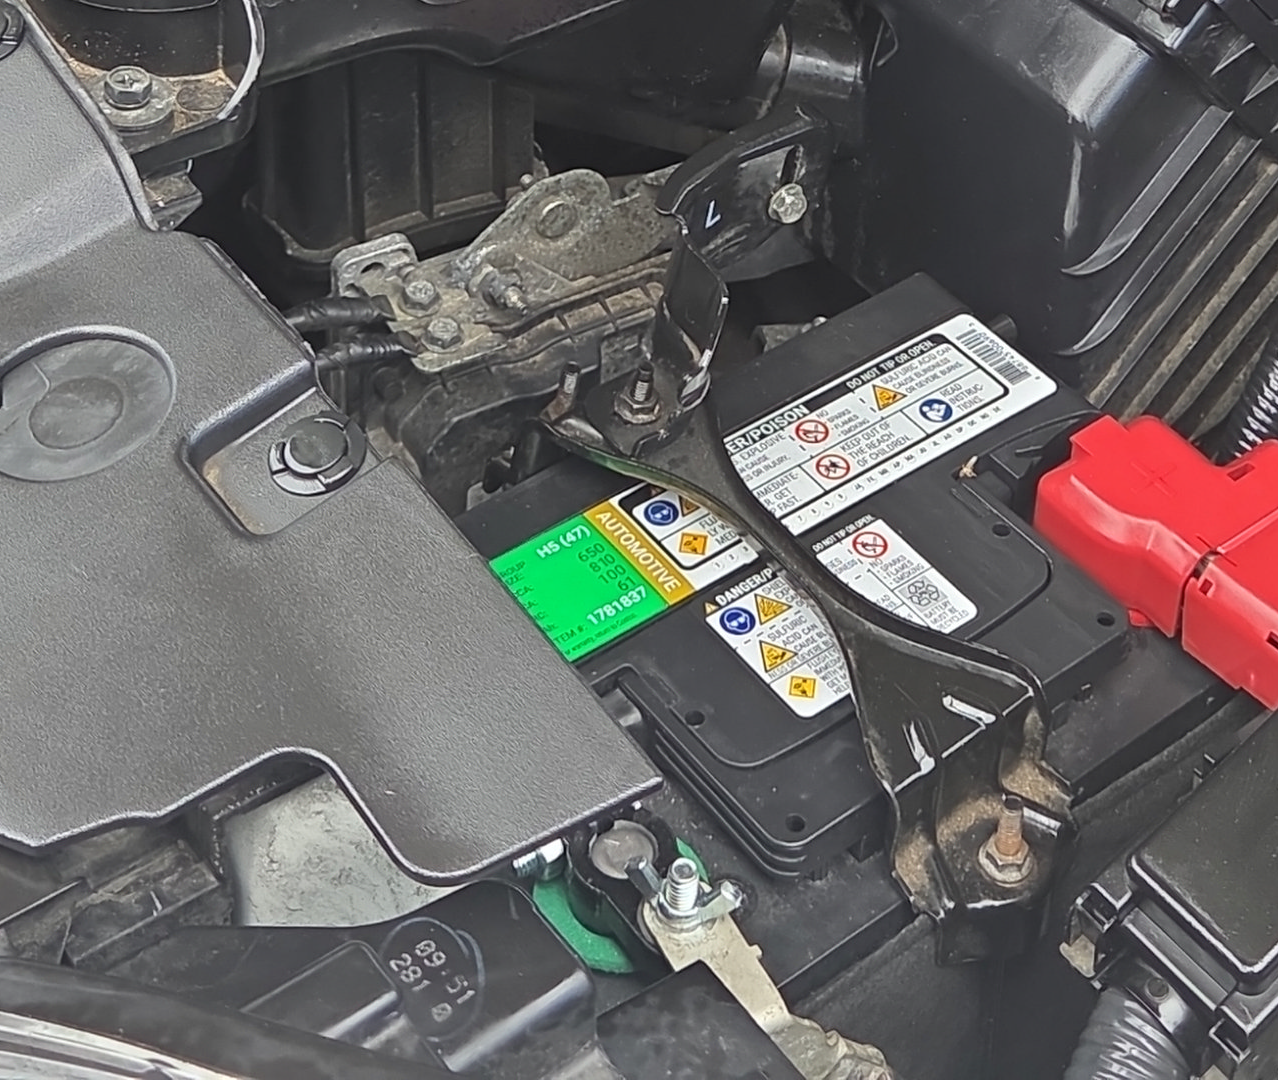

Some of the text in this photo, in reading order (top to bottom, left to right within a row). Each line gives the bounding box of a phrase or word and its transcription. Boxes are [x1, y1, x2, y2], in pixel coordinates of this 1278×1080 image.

[846, 377, 862, 389] DO
[860, 367, 880, 382] NOT
[879, 359, 895, 371] TIP
[894, 353, 911, 363] OR
[907, 340, 936, 357] OPEN.
[880, 363, 918, 385] SULFURIC
[917, 353, 937, 366] ACID
[939, 383, 962, 398] READ
[839, 421, 890, 452] KEEP OUT OF
[847, 431, 895, 460] THE REACH
[856, 434, 913, 467] OF CHILDREN.
[773, 486, 792, 500] GET
[536, 525, 591, 558] H5 (47)
[812, 542, 824, 552] DO
[821, 534, 837, 546] NOT
[834, 529, 846, 539] TIP
[845, 524, 857, 533] OR
[578, 542, 605, 562] 650
[589, 553, 616, 573] 810
[595, 511, 682, 593] AUTOMOTIVE
[868, 556, 883, 569] NO
[597, 564, 627, 584] 100
[617, 576, 636, 591] 61
[553, 629, 577, 644] TEM
[586, 585, 646, 625] 1781837
[767, 615, 808, 642] SULFURIC
[782, 623, 819, 647] ACID CAN
[793, 635, 818, 652] CAUSE
[826, 676, 841, 689] GET
